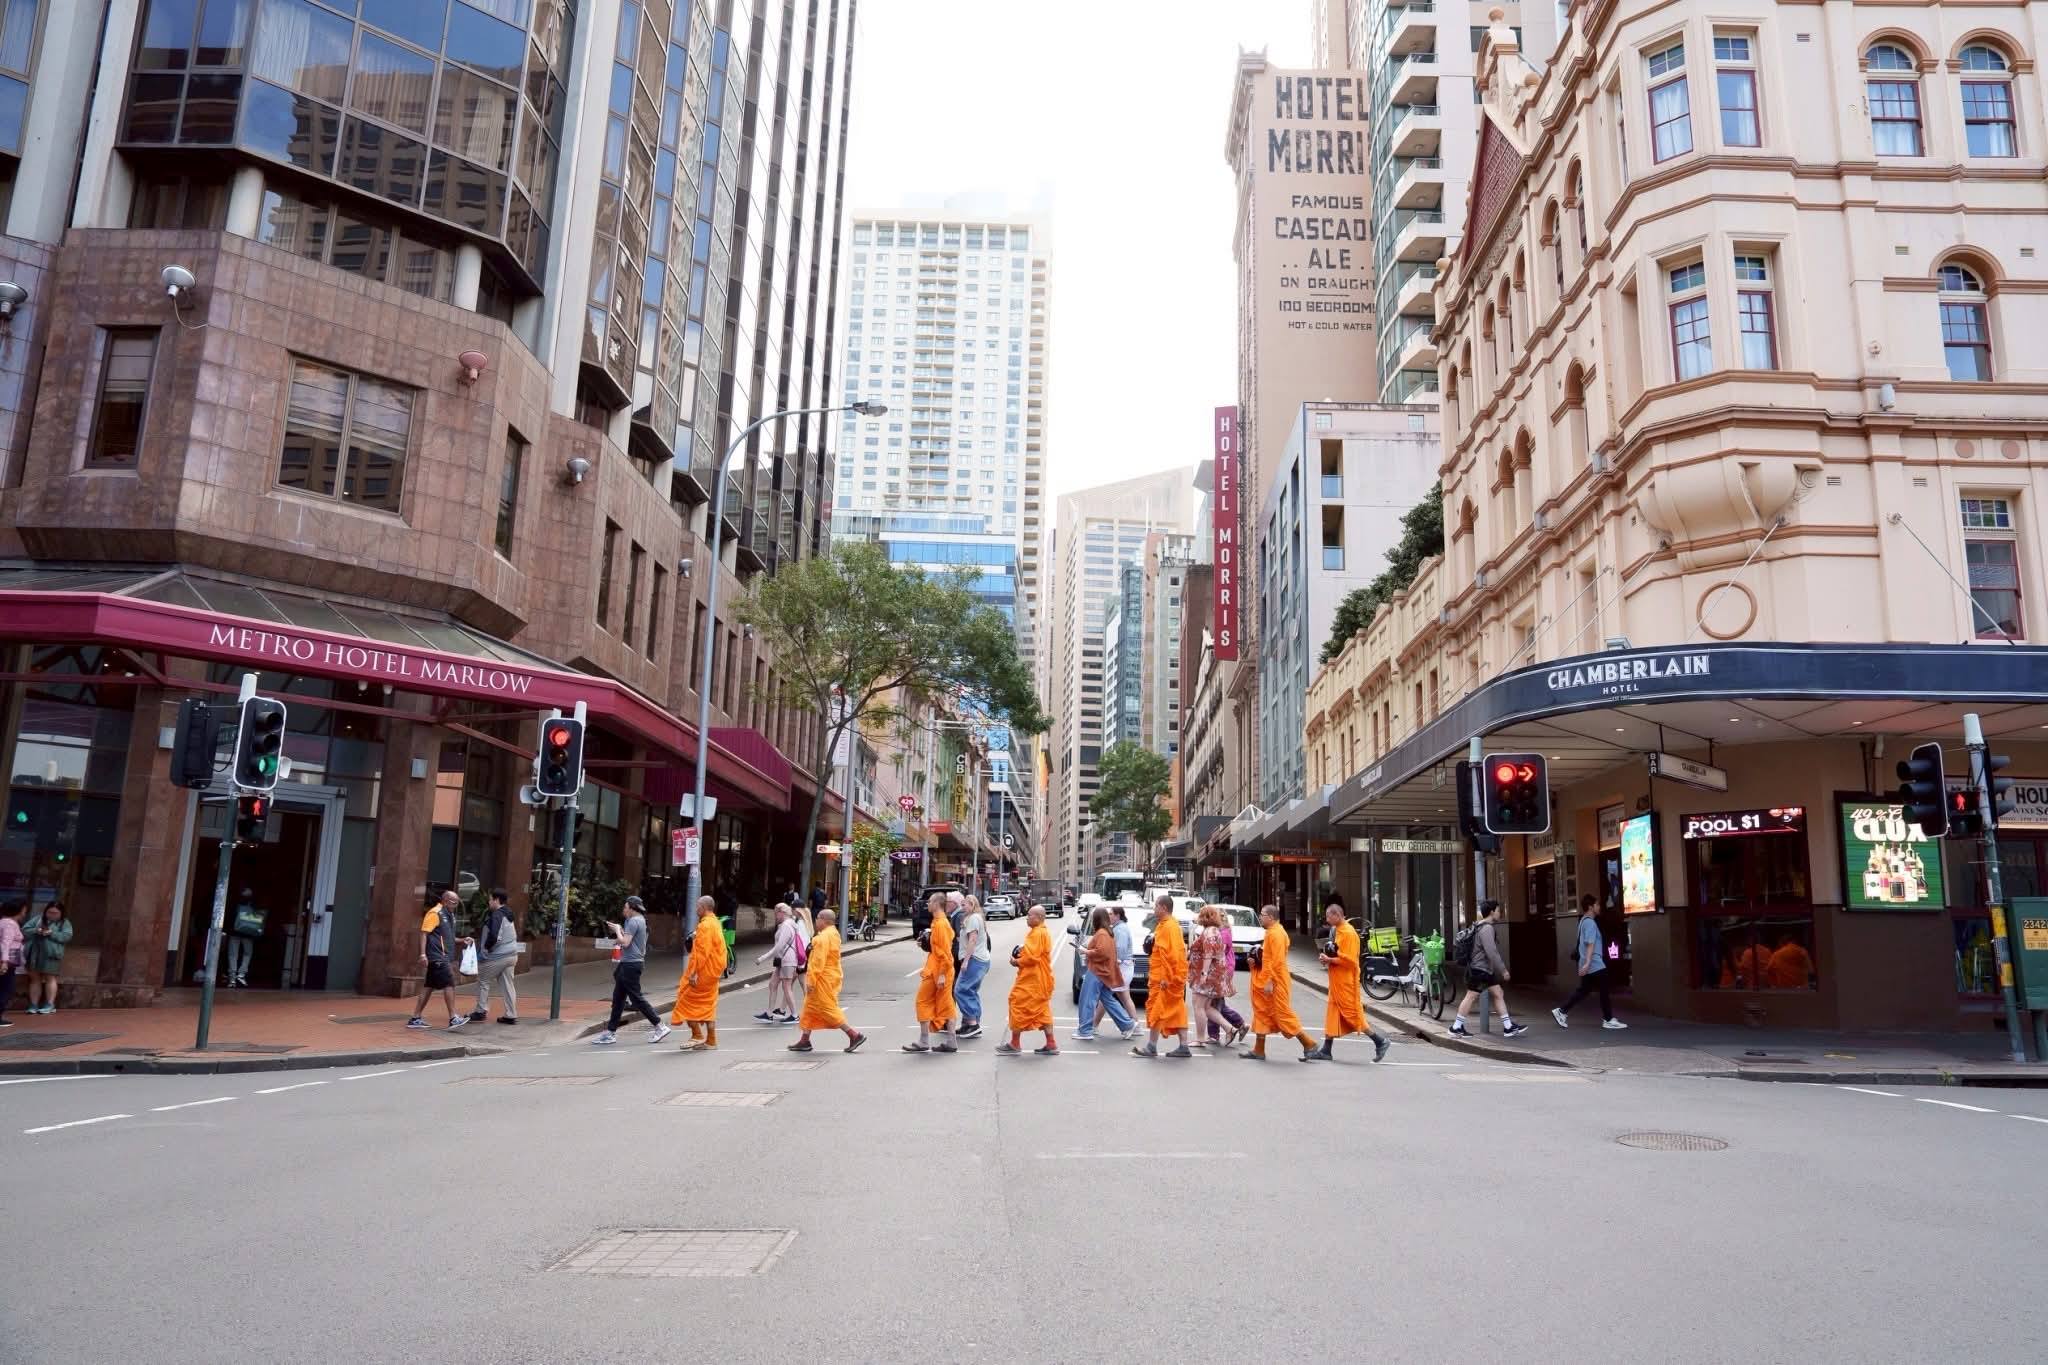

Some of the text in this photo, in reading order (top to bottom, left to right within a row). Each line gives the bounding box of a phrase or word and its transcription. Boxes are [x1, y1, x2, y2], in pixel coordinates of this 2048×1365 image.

[1276, 76, 1369, 121] HOTEL
[1267, 128, 1371, 175] MORRI
[1291, 195, 1364, 210] FAMOUS
[1275, 216, 1373, 241] CASCAD
[1308, 247, 1351, 270] ALE
[1280, 277, 1376, 290] ON DRAUGHT
[1279, 300, 1302, 312] 100
[1288, 321, 1306, 329] HOT
[1315, 321, 1340, 330] COLD
[1342, 322, 1373, 332] WATER
[1219, 416, 1232, 647] HOTEL MORRIS
[208, 623, 535, 695] METRO HOTEL MARLOW
[1547, 654, 1711, 690] CHAMBERLAIN
[1603, 682, 1640, 695] HOTEL
[1649, 752, 1657, 774] BAR
[1688, 814, 1760, 834] POOL $1
[1383, 842, 1406, 850] YDNEY
[2023, 919, 2048, 929] 2342
